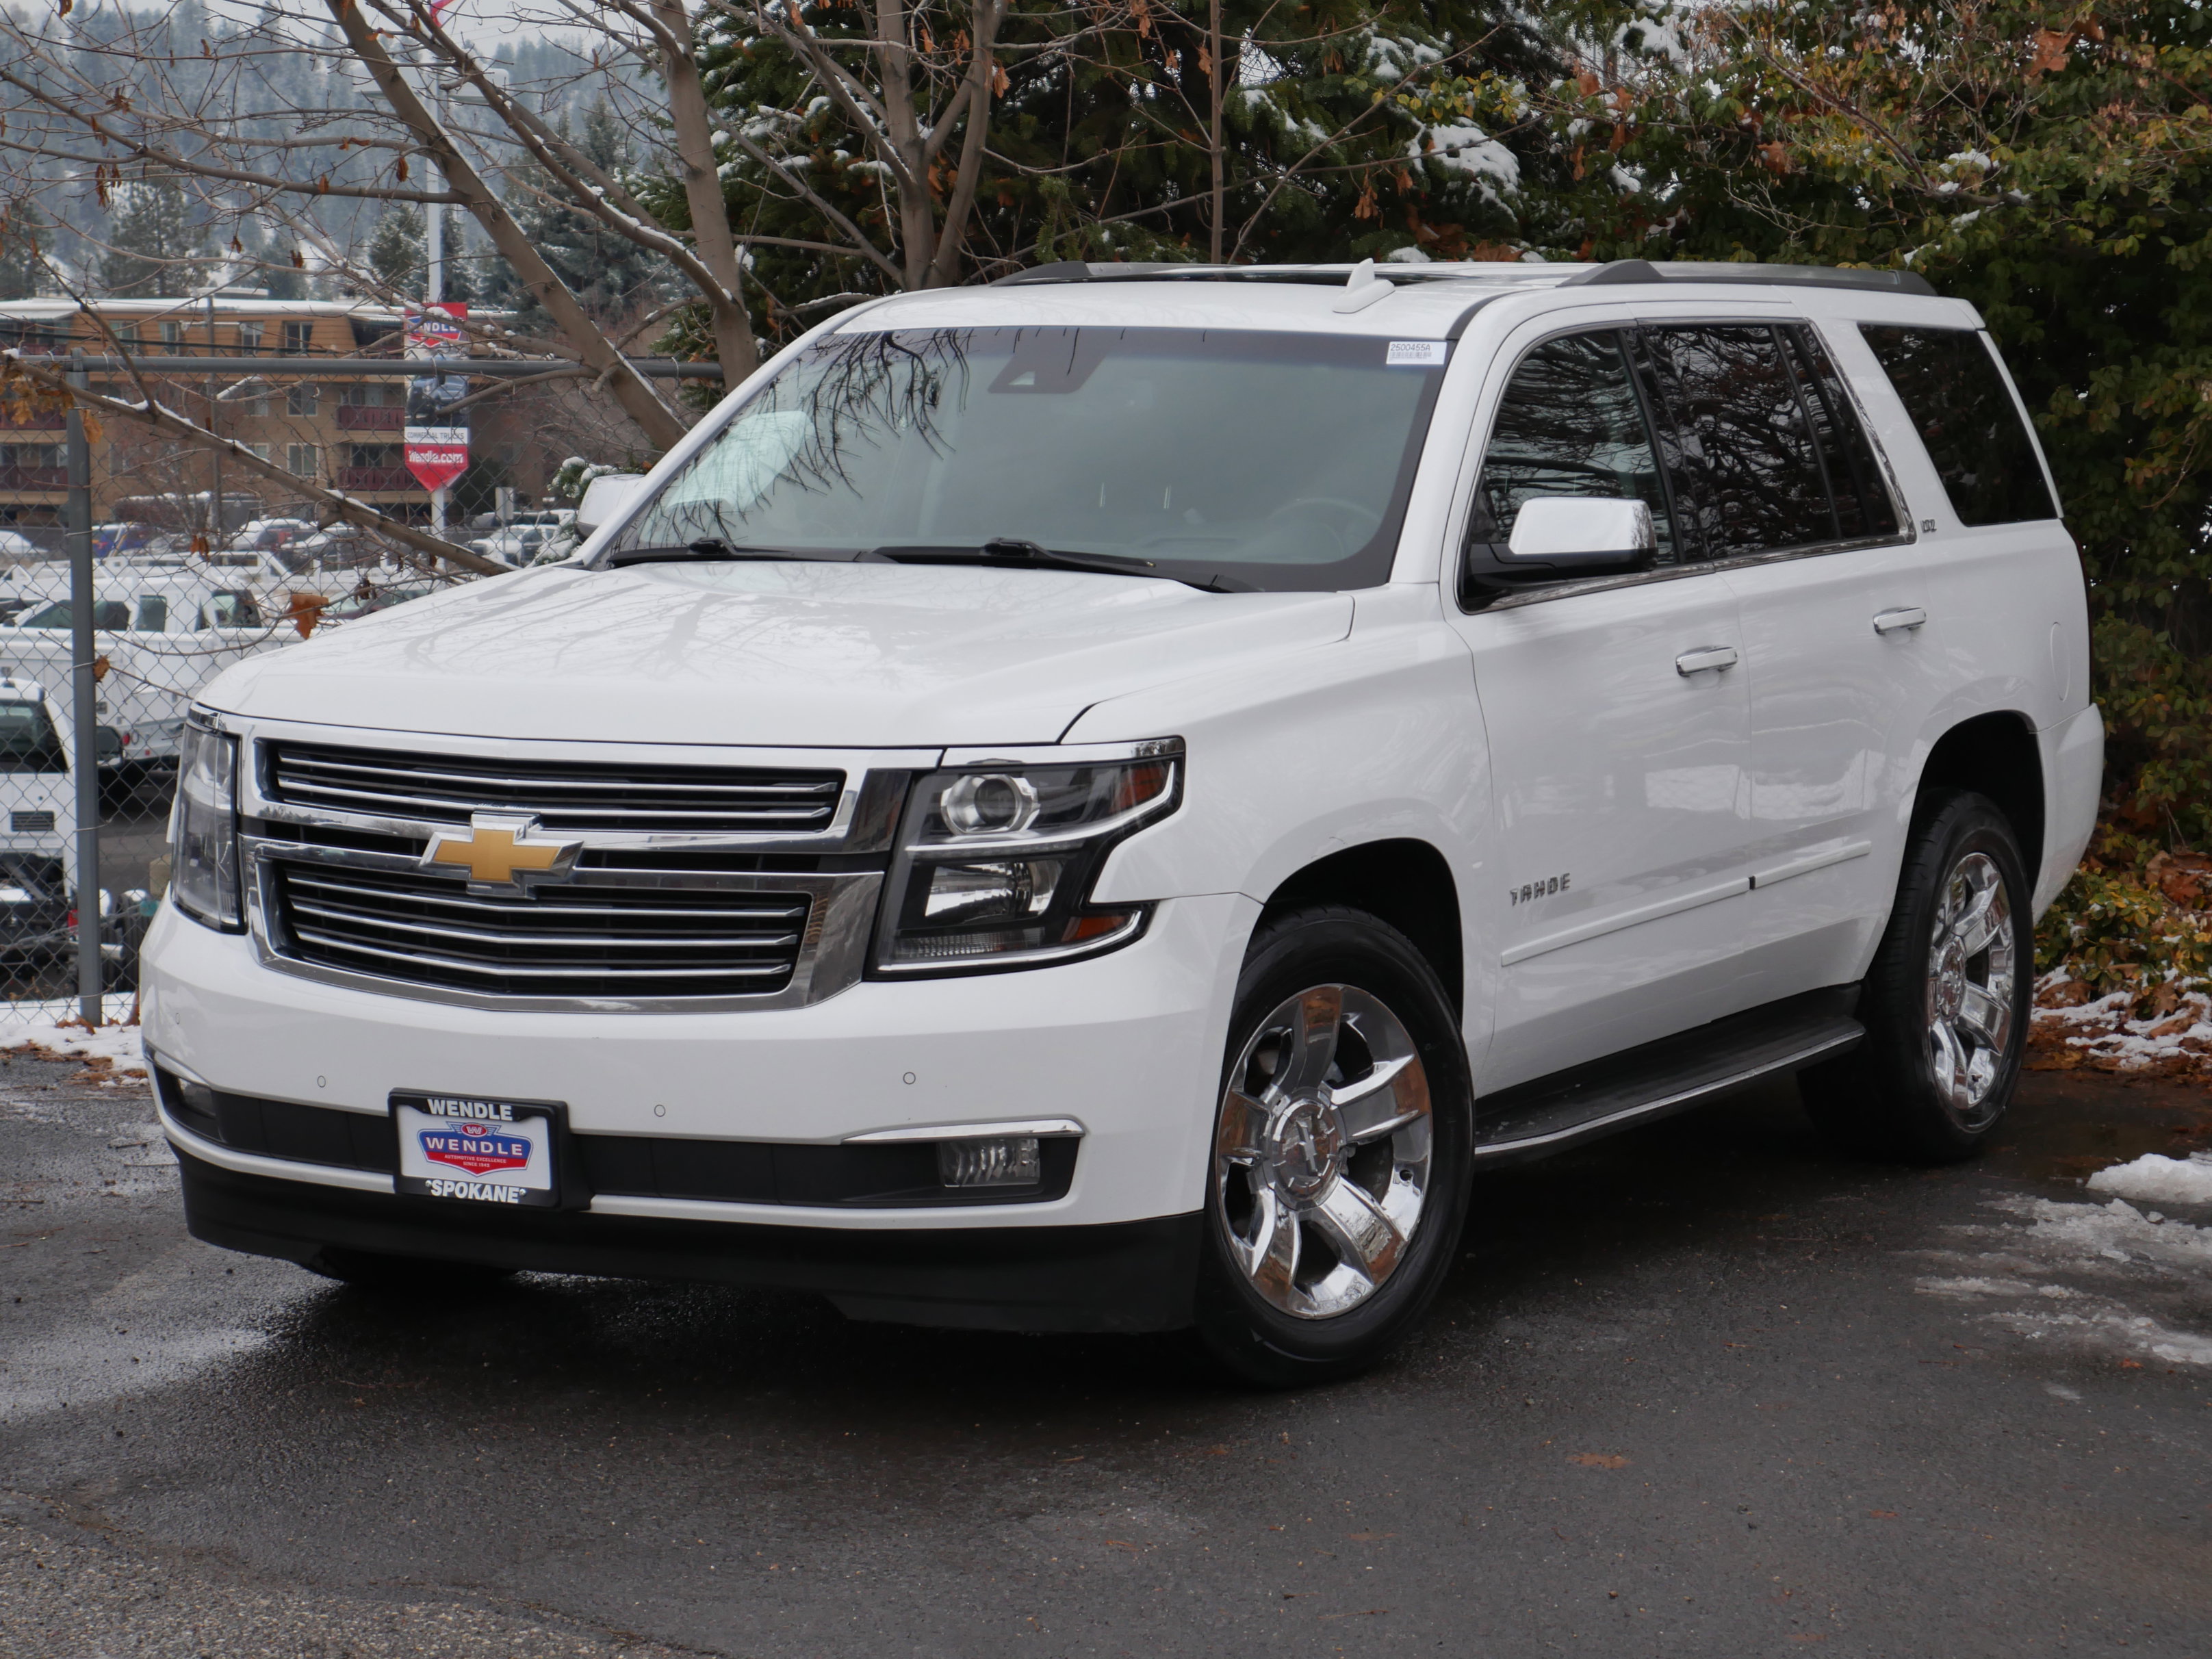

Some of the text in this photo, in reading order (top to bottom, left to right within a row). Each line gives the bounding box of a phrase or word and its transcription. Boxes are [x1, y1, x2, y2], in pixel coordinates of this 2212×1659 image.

[409, 450, 465, 463] Wendle.com
[1510, 873, 1571, 907] TAHOE
[427, 1098, 513, 1121] WENDLE
[425, 1137, 522, 1156] WENDLE
[430, 1179, 519, 1204] SPOKANE
